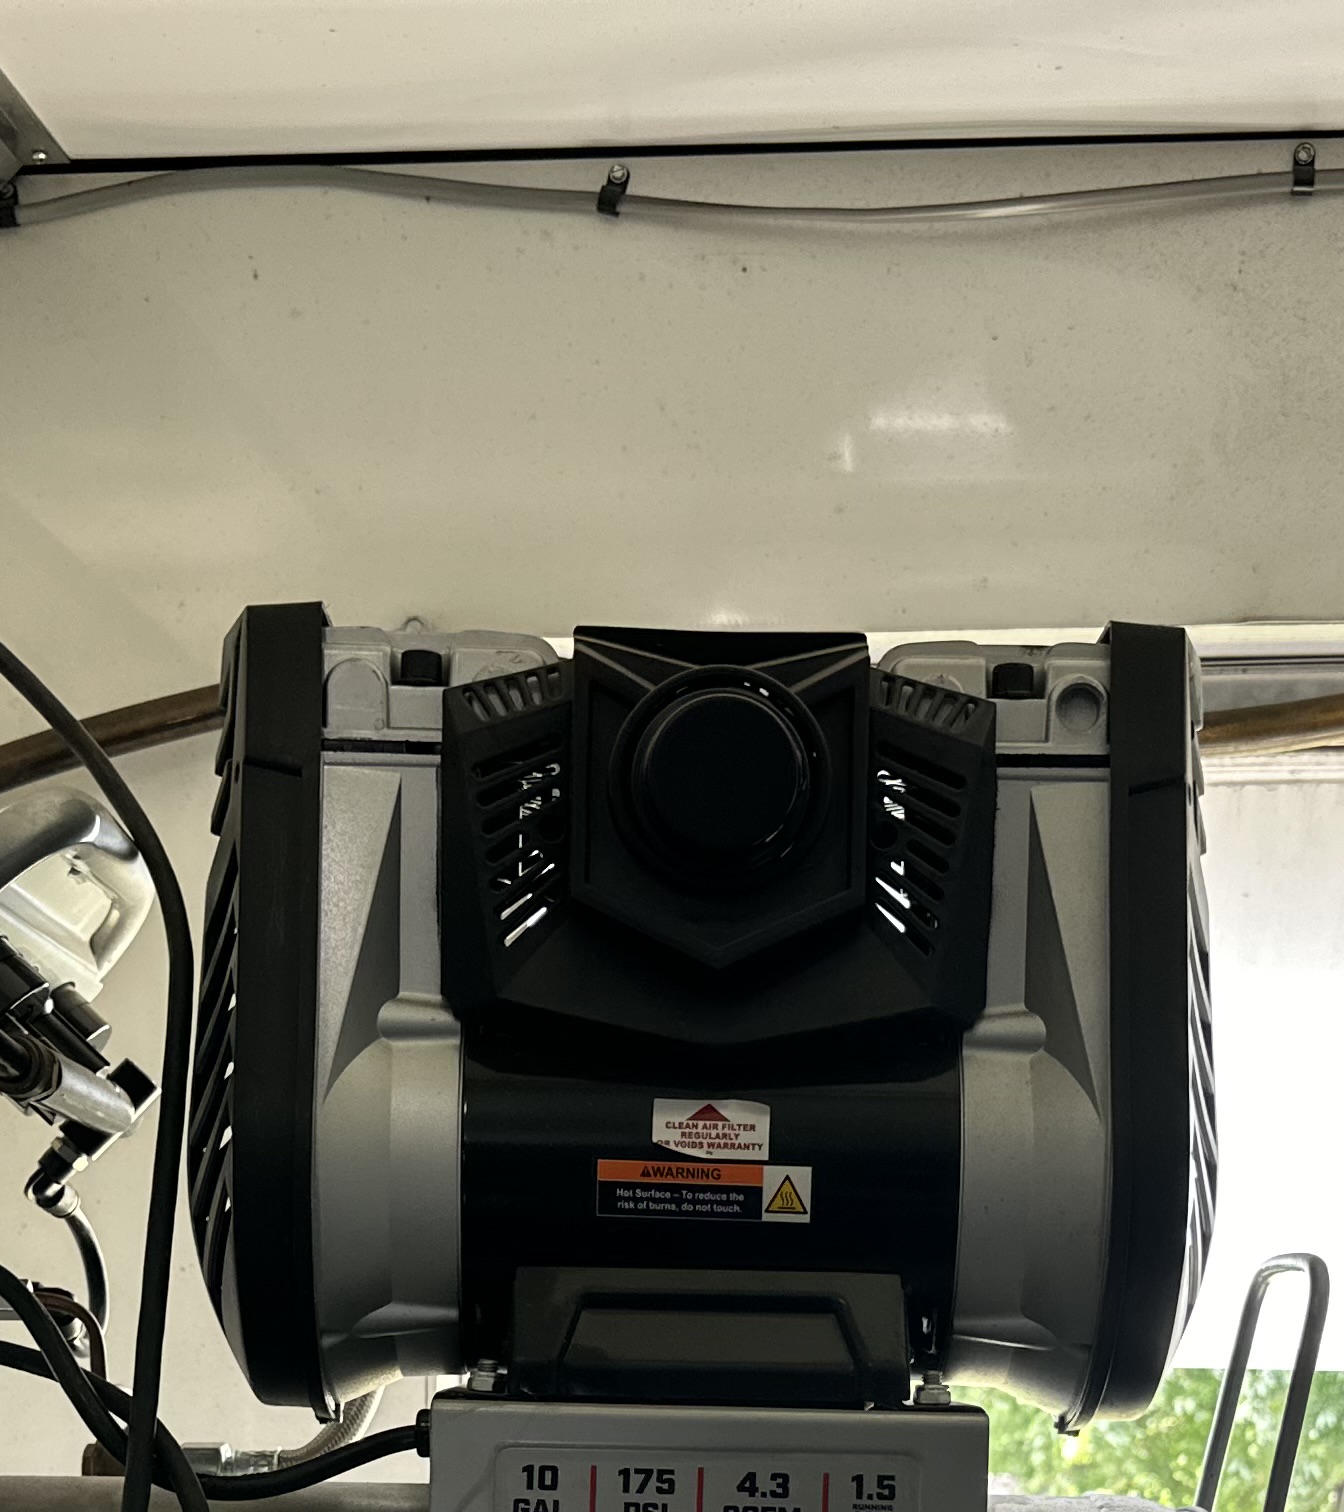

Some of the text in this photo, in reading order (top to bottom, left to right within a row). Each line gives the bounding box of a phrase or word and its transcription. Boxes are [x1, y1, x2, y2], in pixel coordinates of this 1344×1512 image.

[665, 1121, 756, 1132] CLEAN AIR FILTER
[680, 1131, 740, 1141] REGULARLY
[673, 1140, 704, 1149] VOIDS
[706, 1142, 764, 1151] WARRANTY
[651, 1166, 722, 1180] WARNING
[616, 1188, 633, 1198] Hot
[635, 1188, 672, 1199] Surface
[681, 1190, 693, 1200] To
[694, 1191, 727, 1201] reduce
[729, 1191, 745, 1201] the
[617, 1200, 743, 1213] risk of burns, do not touch.
[521, 1464, 559, 1491] 10
[617, 1467, 675, 1495] 175
[735, 1471, 790, 1499] 4.3
[851, 1473, 896, 1500] 1.5
